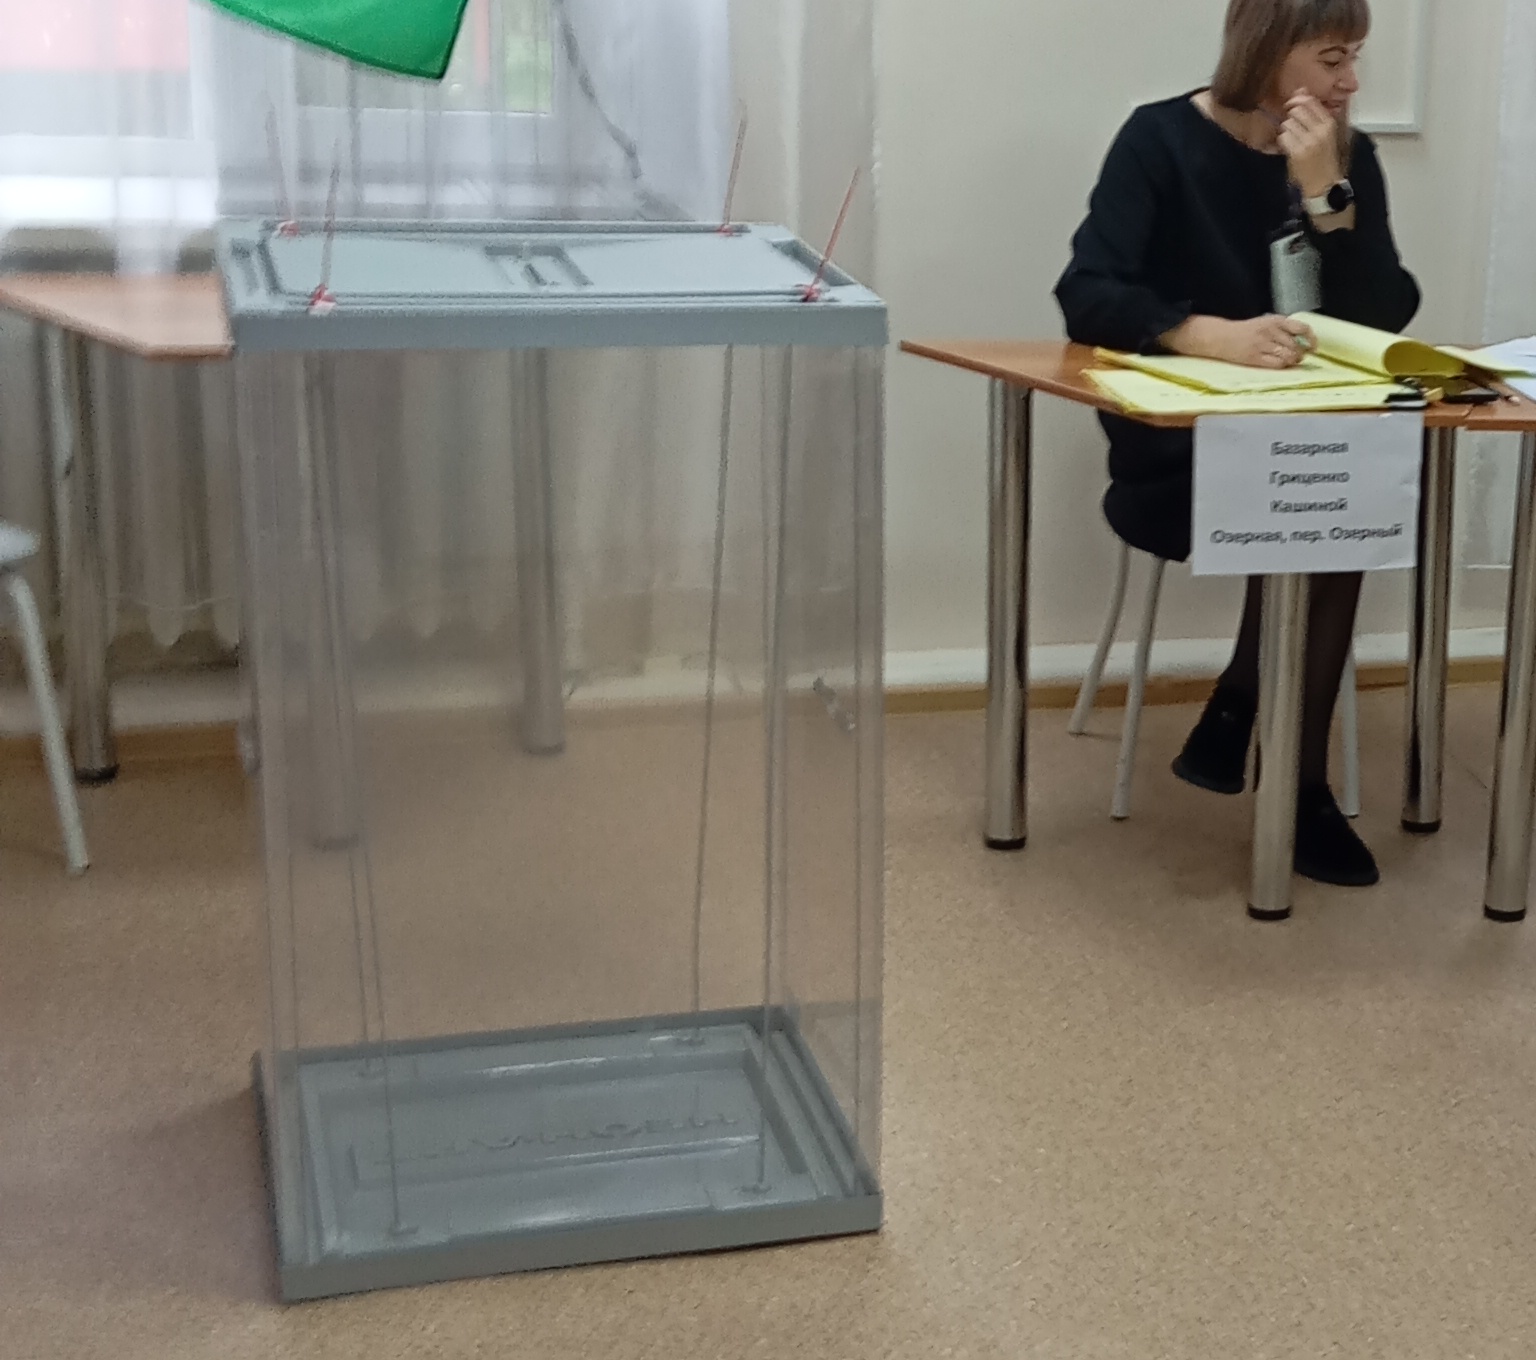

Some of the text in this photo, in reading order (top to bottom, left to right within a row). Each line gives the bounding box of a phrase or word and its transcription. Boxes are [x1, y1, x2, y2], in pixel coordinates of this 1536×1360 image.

[1270, 441, 1349, 457] Базарная
[1269, 470, 1350, 488] Гриценко
[1269, 497, 1349, 513] Кашиной
[1329, 523, 1405, 541] Озерный
